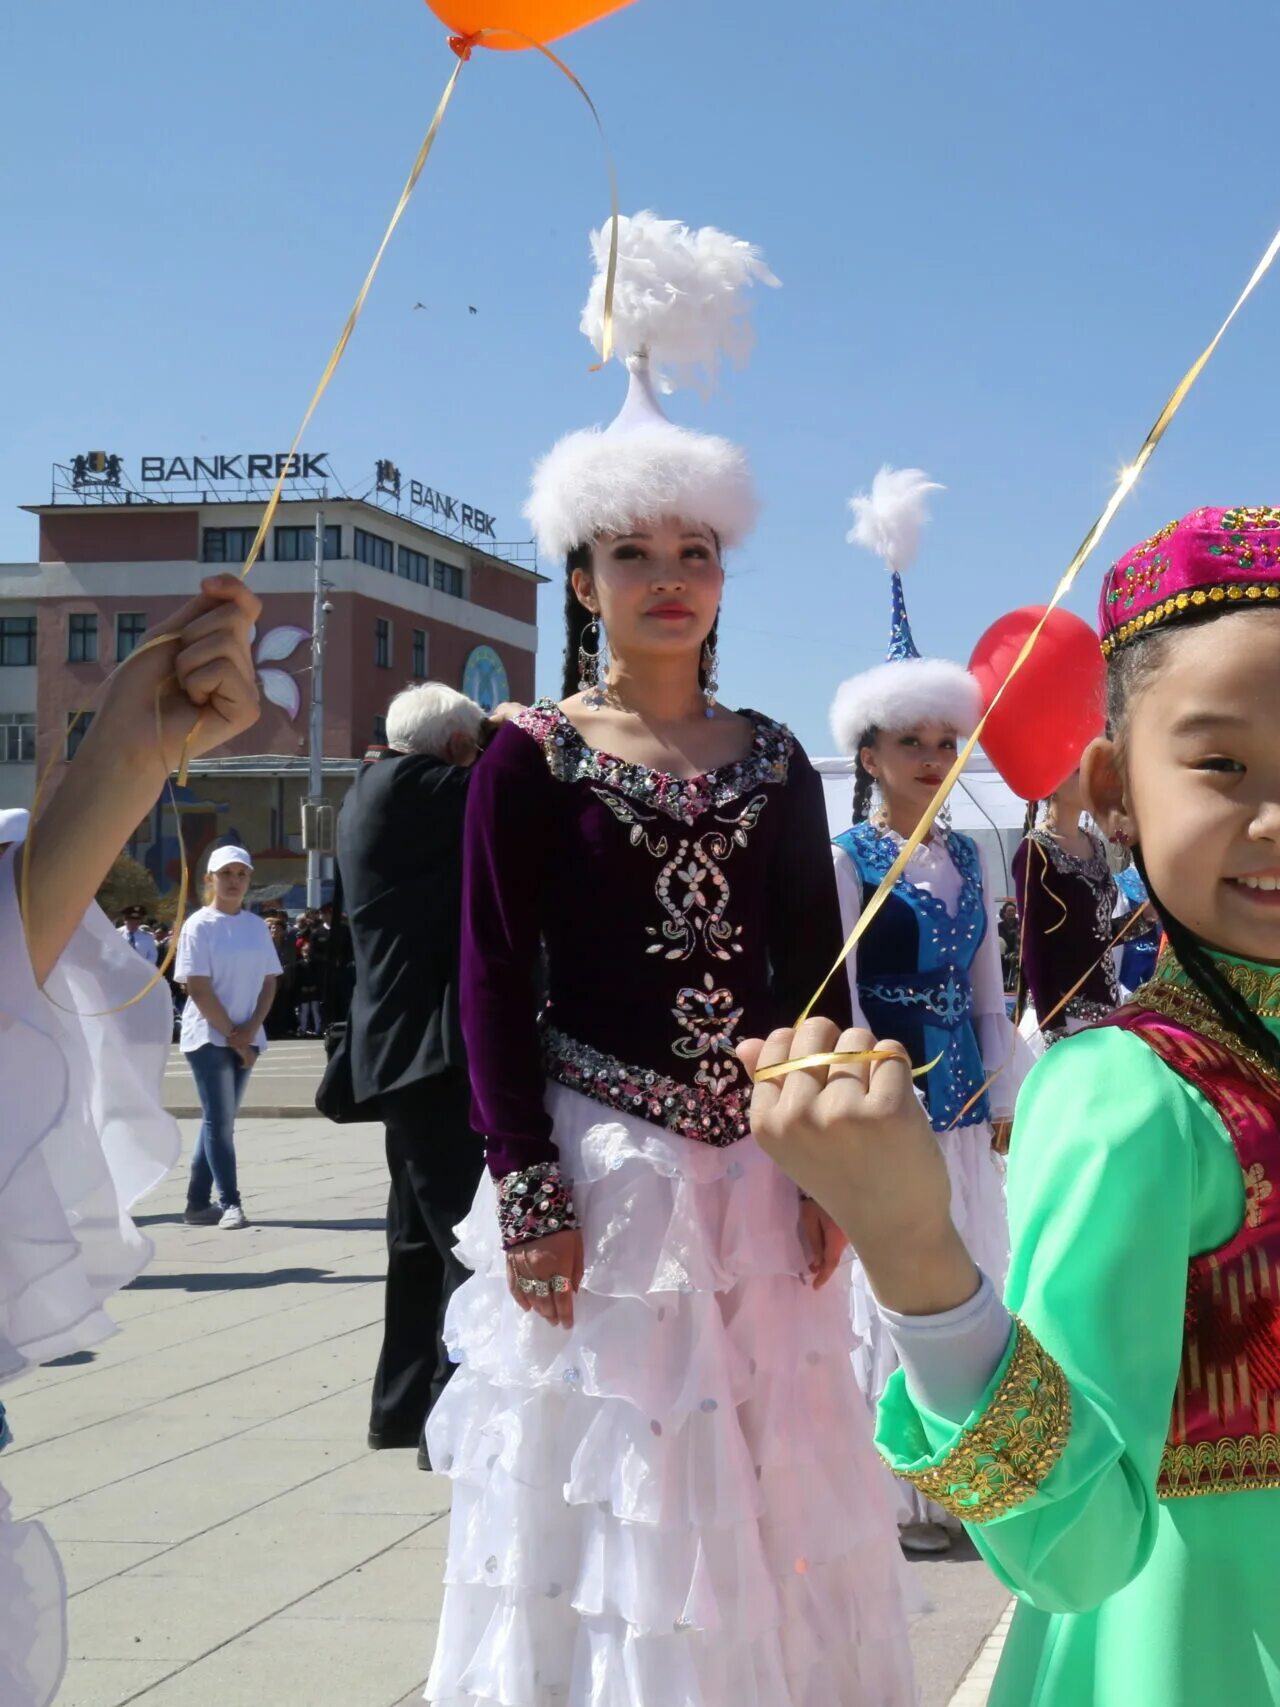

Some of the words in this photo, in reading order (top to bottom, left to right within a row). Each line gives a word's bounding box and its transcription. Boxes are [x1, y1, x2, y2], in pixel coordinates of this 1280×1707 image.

[141, 455, 244, 482] BANK
[248, 453, 330, 479] RBK
[410, 479, 459, 523] BANK
[461, 503, 497, 539] RBK
